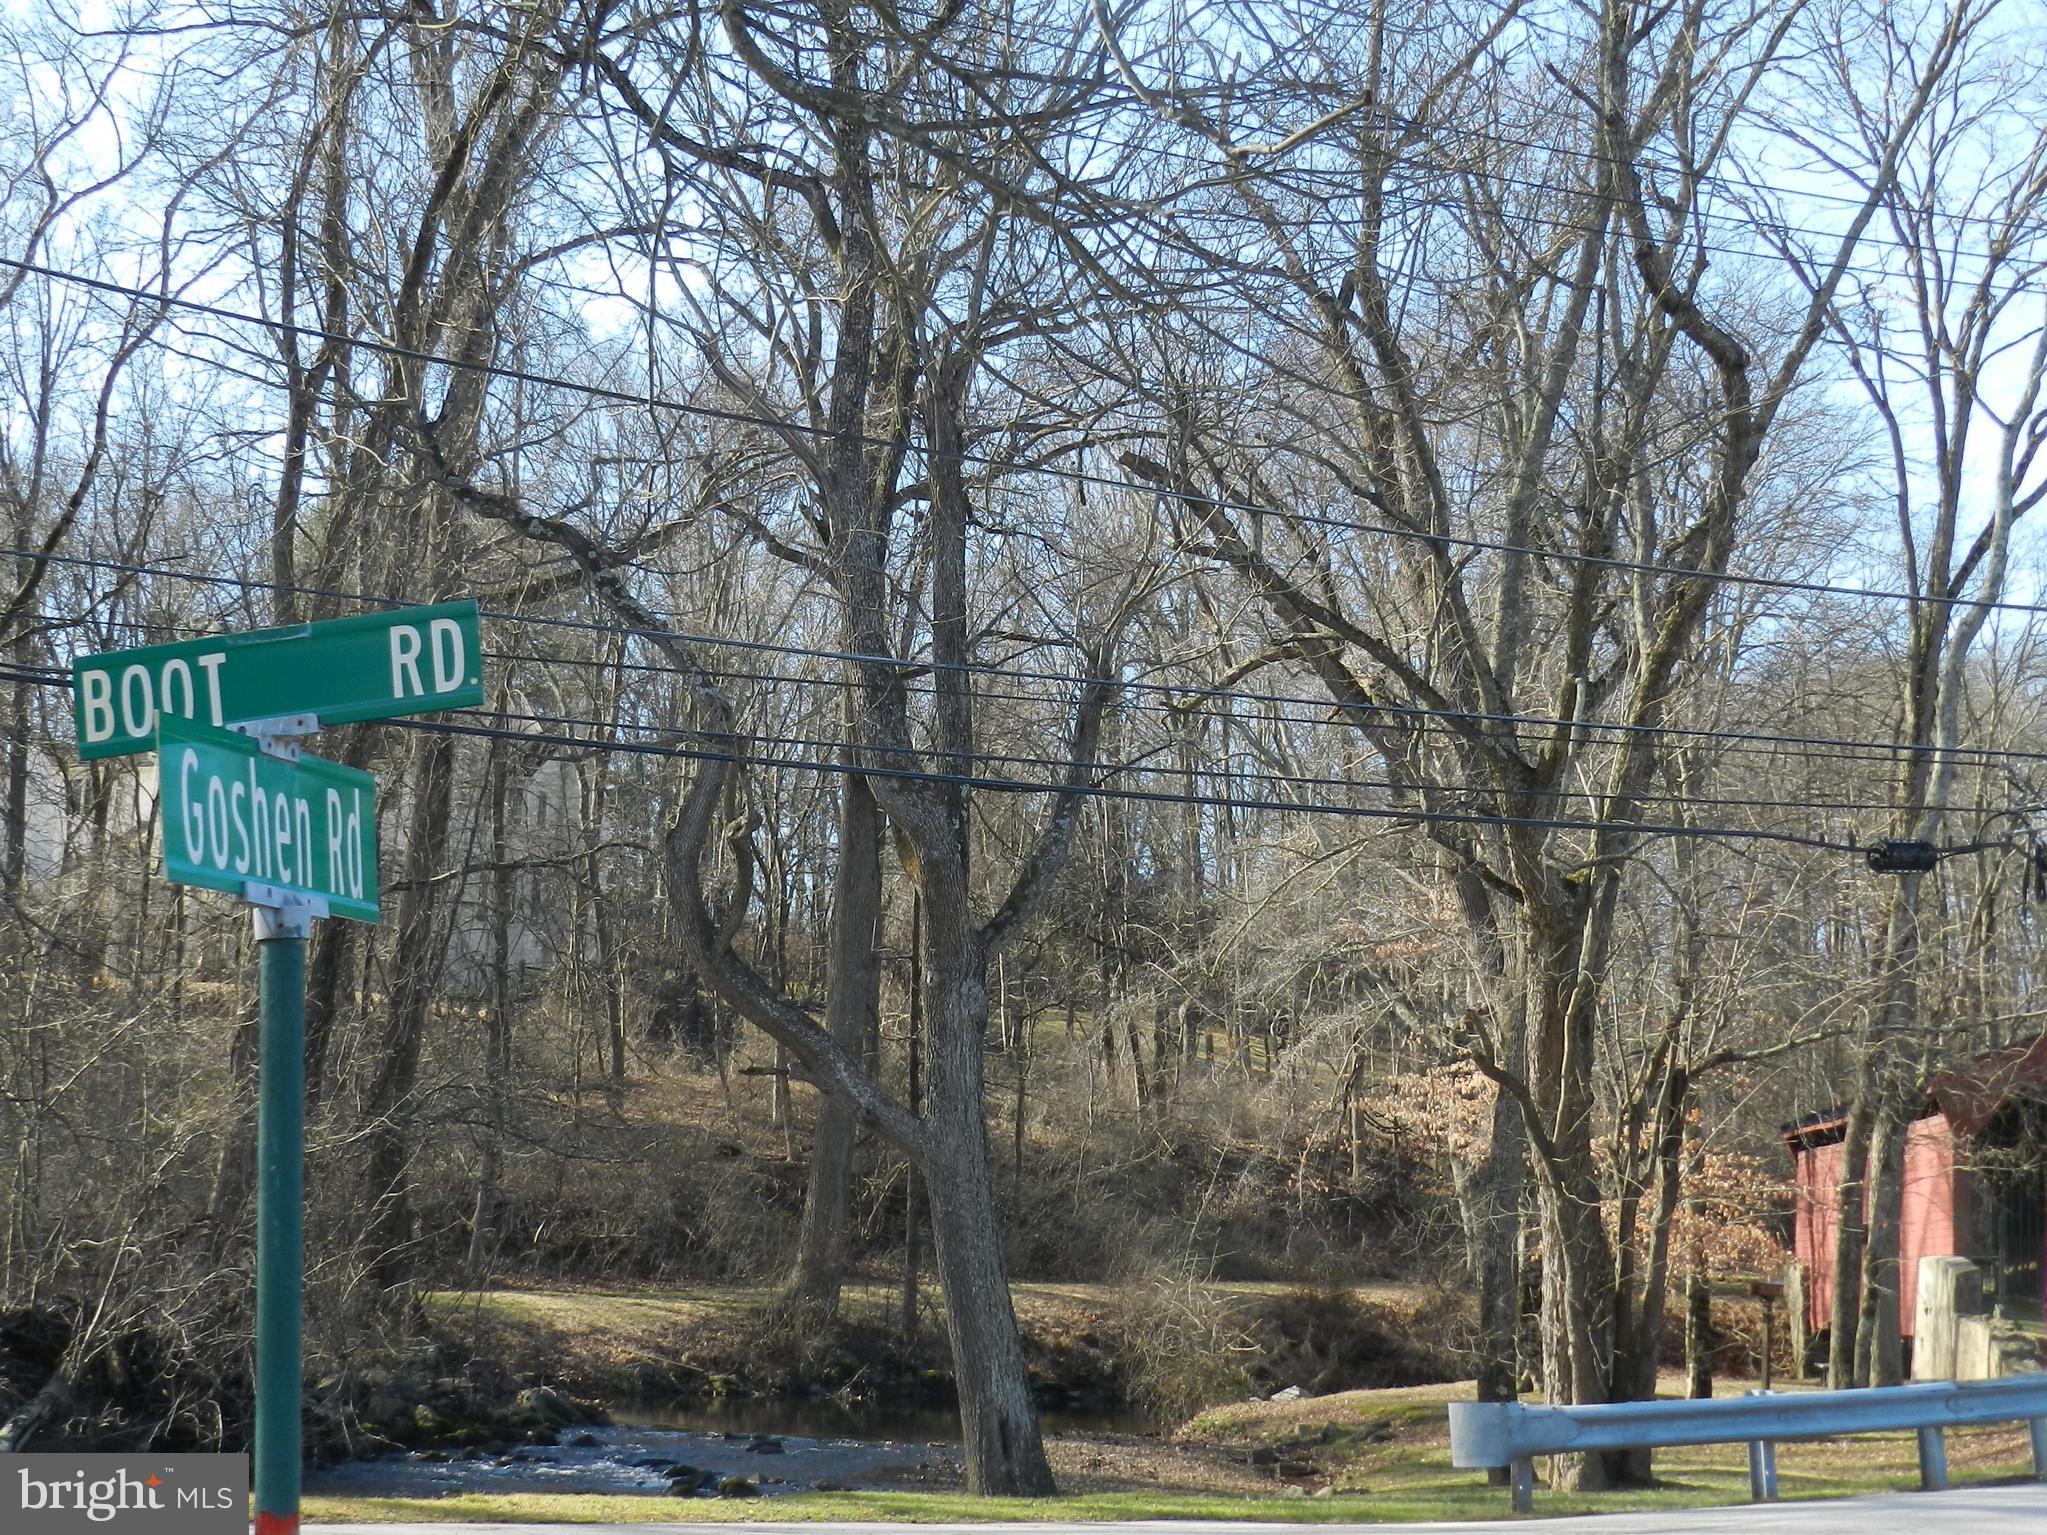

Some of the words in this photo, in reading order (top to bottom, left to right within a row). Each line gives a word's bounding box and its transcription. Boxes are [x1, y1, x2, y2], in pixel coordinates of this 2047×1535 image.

[82, 652, 227, 742] BOOT
[181, 748, 313, 888] Goshen
[327, 787, 363, 899] Rd
